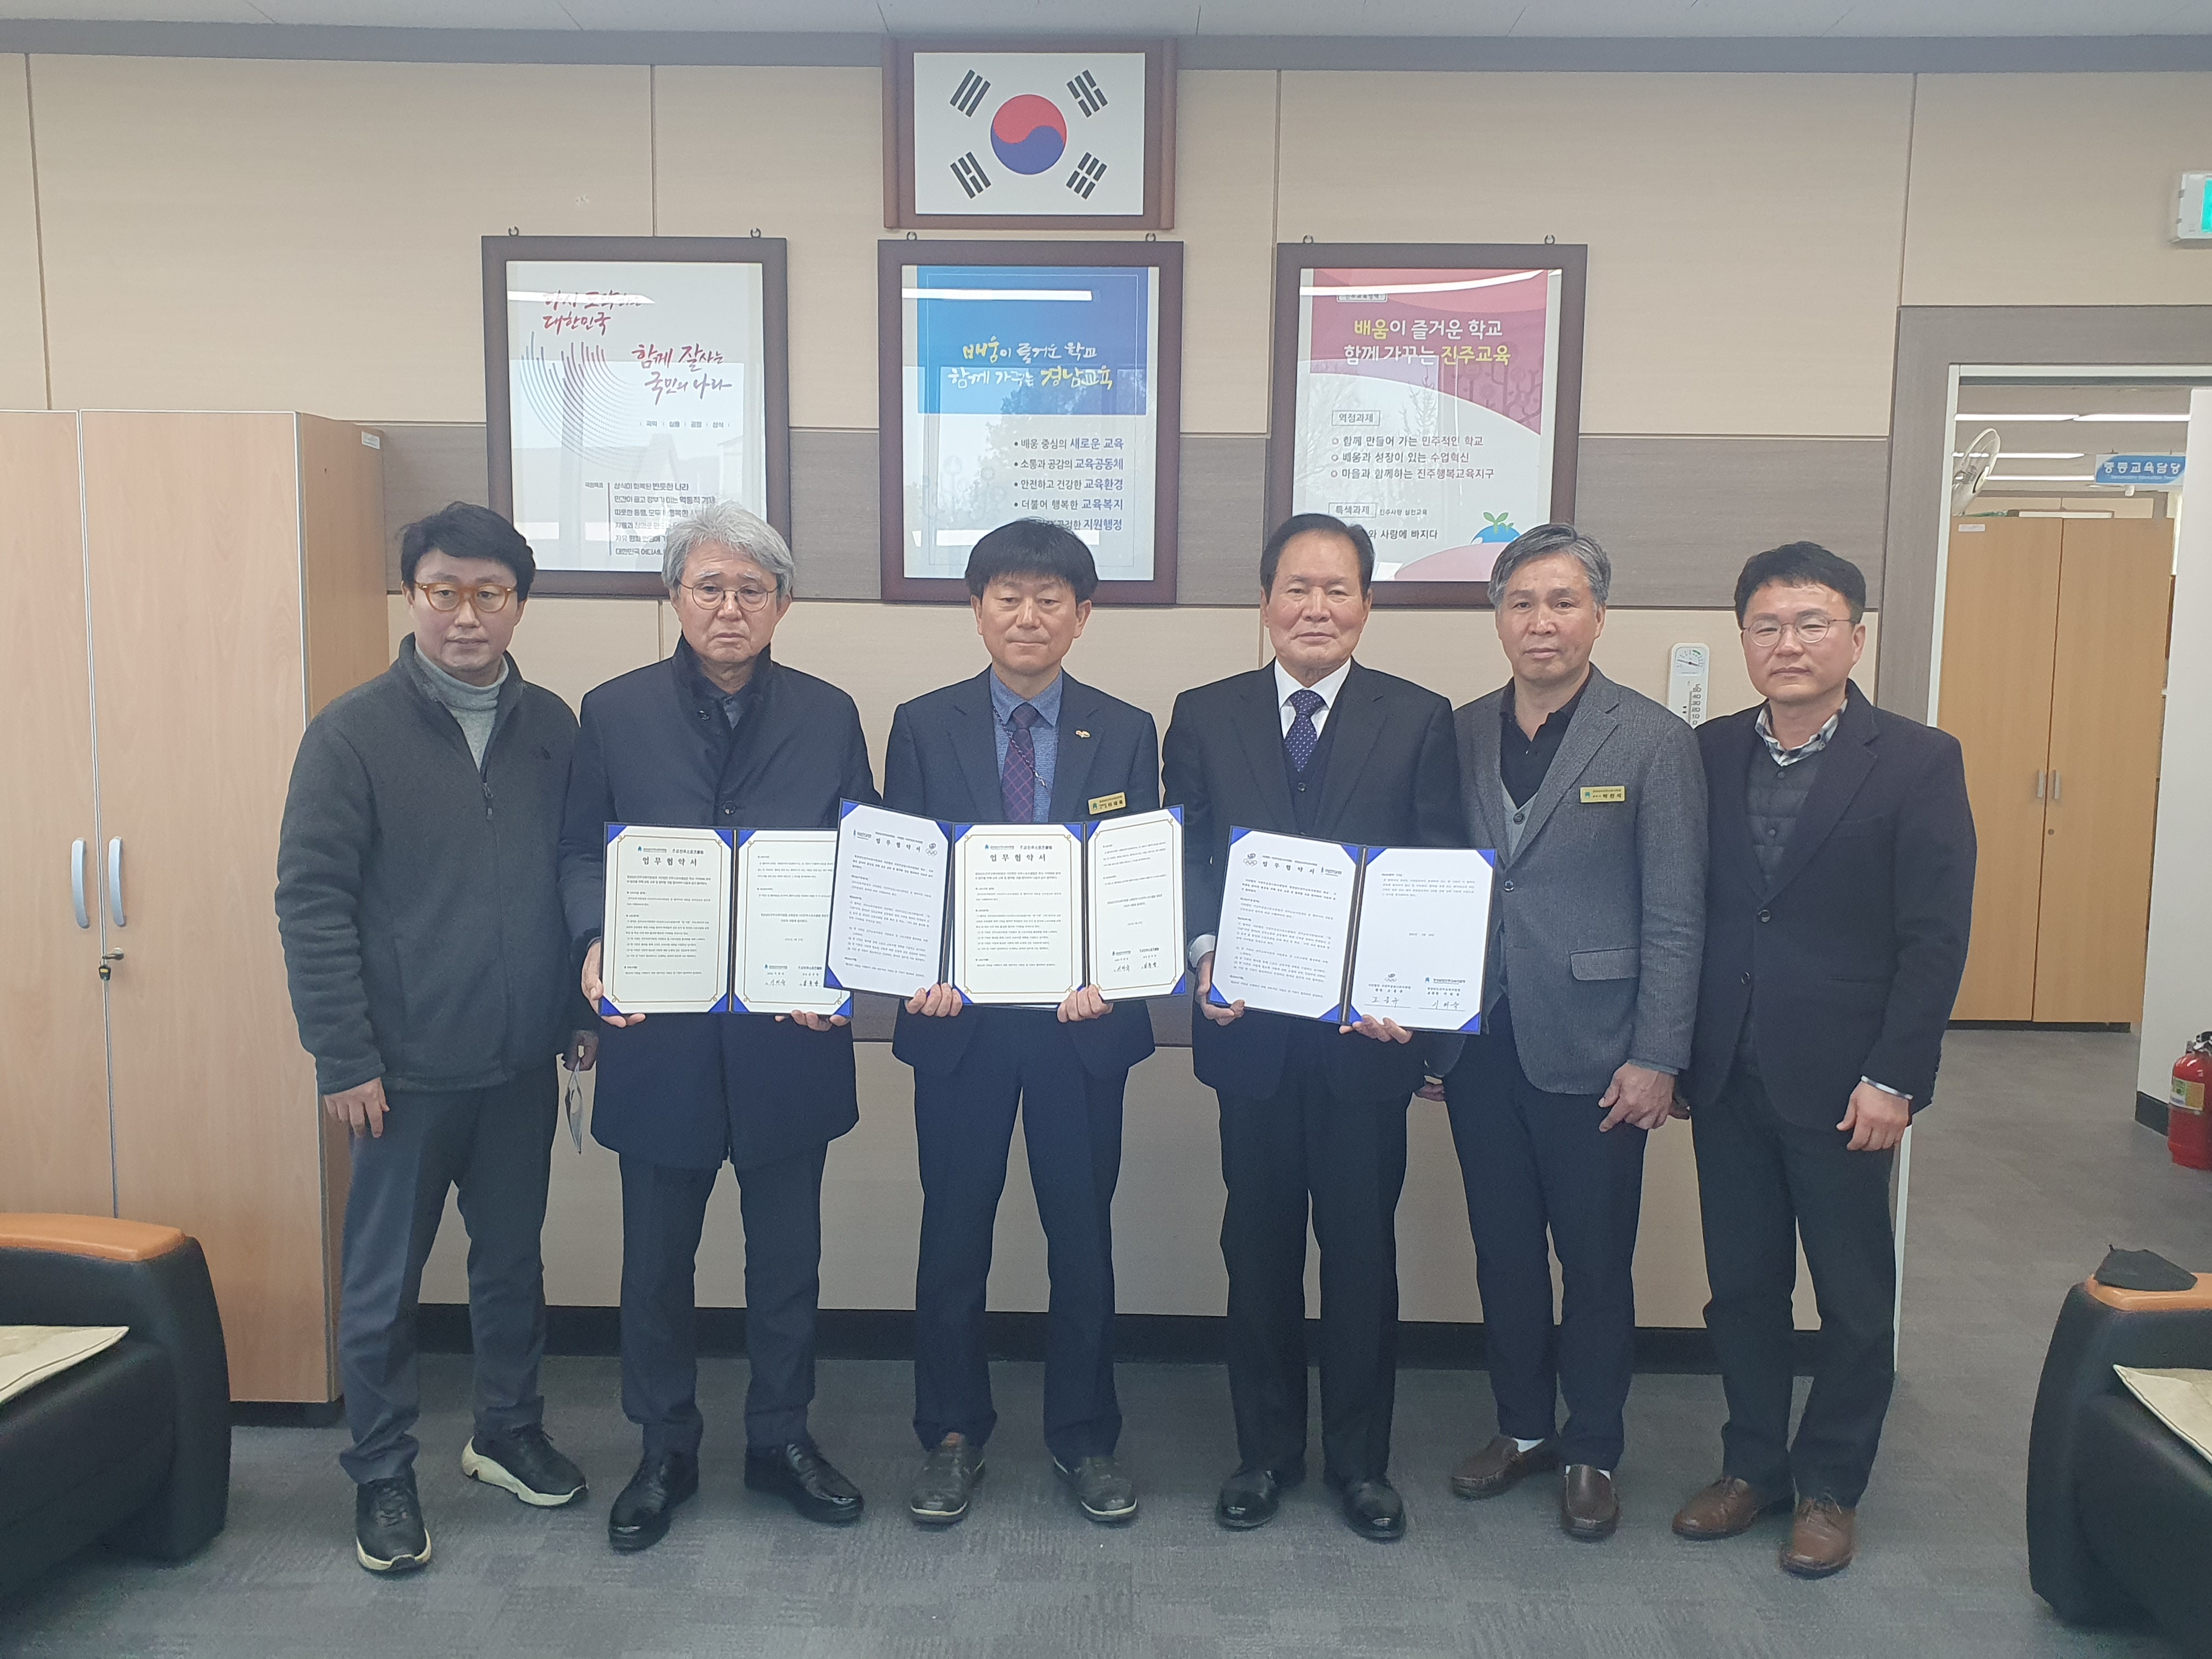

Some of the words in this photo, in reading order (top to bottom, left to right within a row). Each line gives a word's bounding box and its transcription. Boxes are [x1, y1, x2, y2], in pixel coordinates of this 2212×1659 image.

[543, 311, 611, 336] 대한민국
[1354, 319, 1406, 340] 배움이
[1411, 319, 1463, 340] 즐거운
[1468, 319, 1503, 340] 학교
[963, 335, 1012, 363] 배움이
[1017, 342, 1062, 364] 즐거운
[1064, 341, 1097, 361] 학교
[1344, 345, 1379, 365] 함께
[1383, 345, 1438, 365] 가꾸는
[1441, 345, 1511, 366] 진주교육
[631, 343, 673, 369] 함께
[947, 366, 990, 389] 함께
[1040, 364, 1113, 390] 경남교육
[644, 371, 689, 405] 국민의
[693, 373, 732, 399] 나라
[1339, 413, 1373, 423] 역점과제
[1020, 438, 1038, 449] 배움
[1041, 438, 1067, 449] 중심의
[1070, 437, 1101, 450] 새로운
[1103, 438, 1124, 450] 교육
[1343, 436, 1362, 447] 함께
[1366, 436, 1394, 447] 만들어
[1398, 436, 1418, 447] 가는
[1422, 436, 1459, 447] 민주적인
[1464, 436, 1483, 447] 학교
[1020, 459, 1046, 470] 소통과
[1047, 459, 1073, 470] 공감의
[1074, 458, 1124, 470] 교육공동체
[1342, 453, 1371, 463] 배움과
[1375, 453, 1403, 463] 성장이
[1408, 453, 1426, 463] 있는
[1430, 453, 1470, 463] 수업혁신
[1342, 469, 1370, 479] 마을과
[1375, 469, 1413, 479] 함께하는
[1417, 469, 1495, 479] 진주행복교육지구
[652, 483, 674, 491] 반듯한
[675, 483, 689, 491] 나라
[1020, 479, 1054, 490] 안전하고
[1057, 479, 1082, 490] 건강한
[1084, 478, 1123, 490] 교육환경
[1022, 499, 1048, 510] 더불어
[1052, 499, 1079, 510] 행복한
[1081, 499, 1123, 511] 교육복지
[1335, 505, 1370, 515] 특색과제
[1084, 518, 1122, 531] 지원행정
[1380, 529, 1407, 539] 사랑에
[1410, 529, 1438, 539] 빠지다
